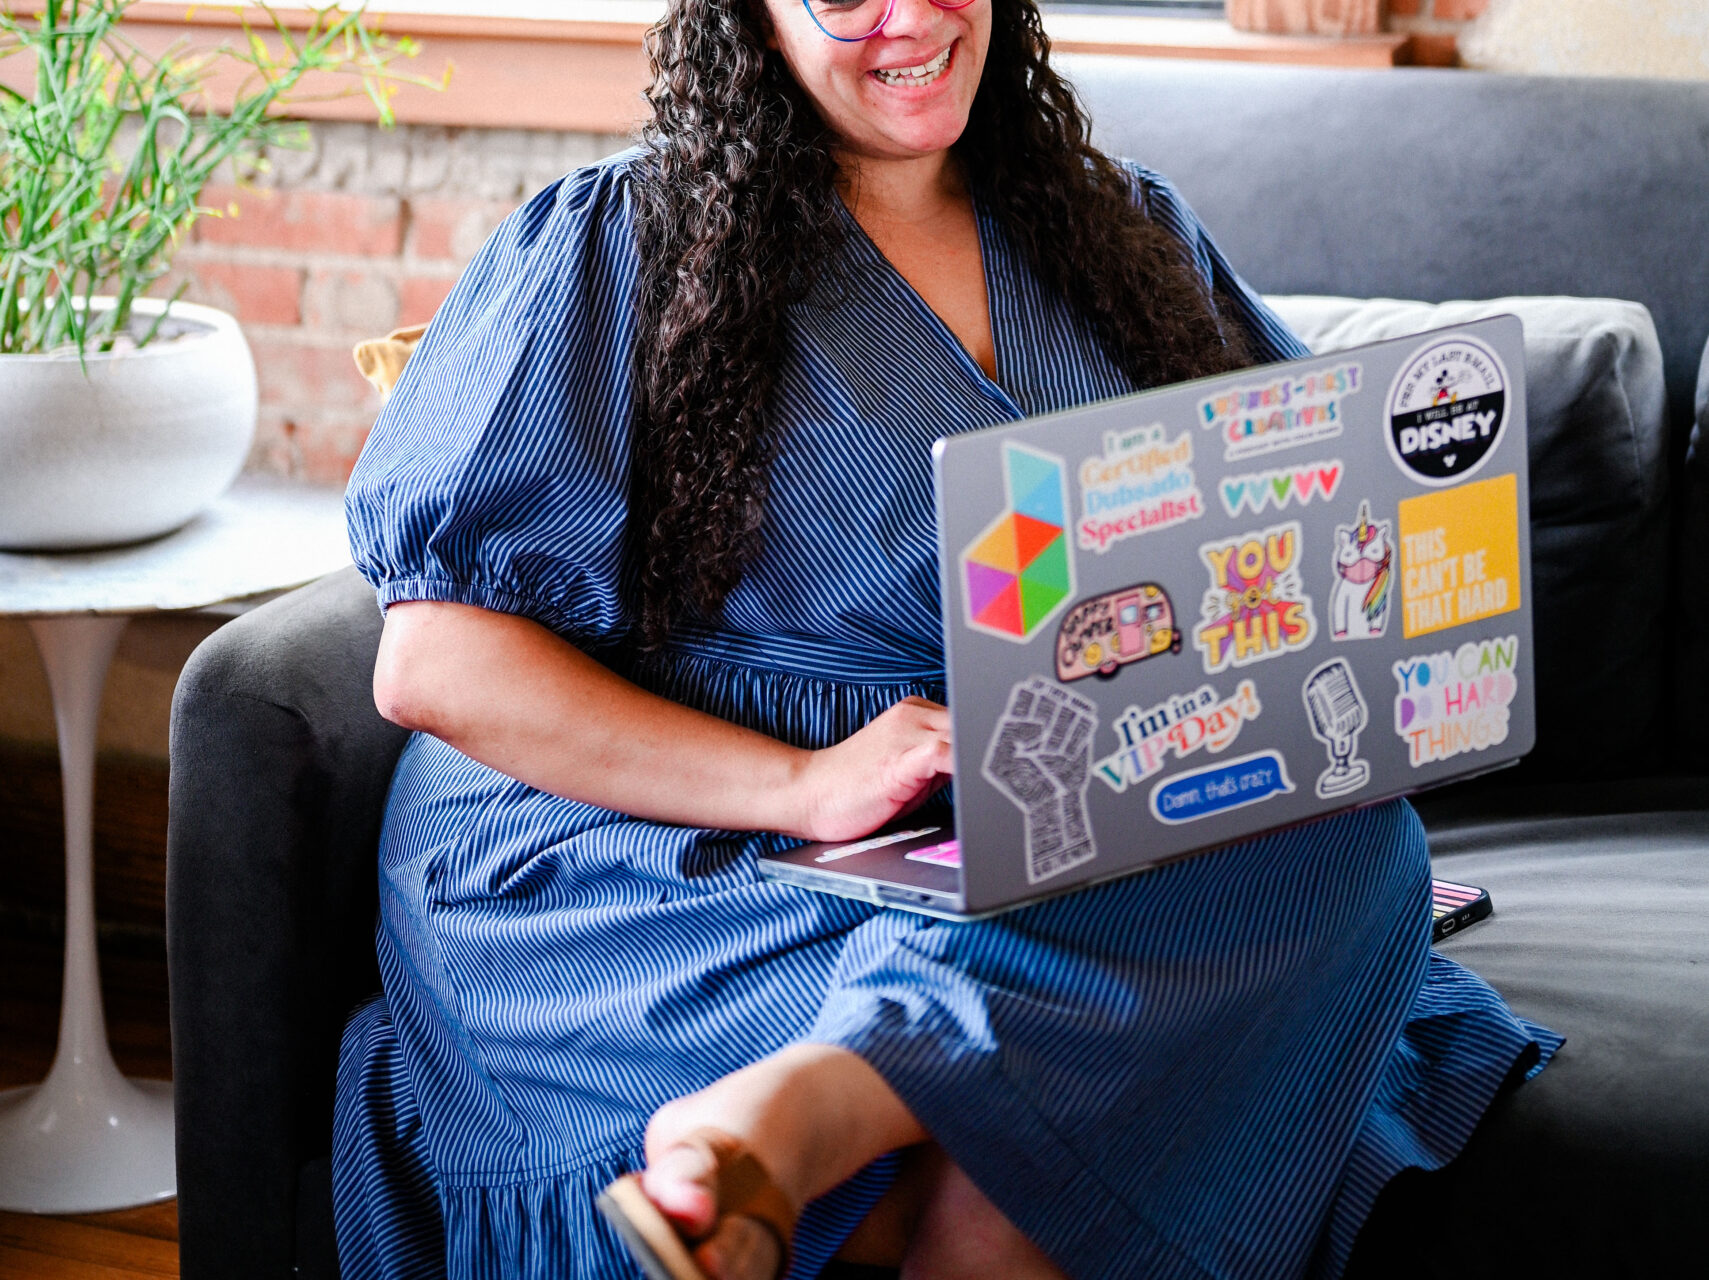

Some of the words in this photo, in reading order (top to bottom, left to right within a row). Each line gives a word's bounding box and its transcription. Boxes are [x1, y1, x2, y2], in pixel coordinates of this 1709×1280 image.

[1107, 436, 1114, 452] I
[1120, 432, 1144, 451] am
[1152, 428, 1161, 441] a
[1399, 408, 1497, 456] DISNEY
[1082, 437, 1192, 485] Certified
[1085, 469, 1192, 516] Dubsado
[1081, 494, 1200, 547] Specialist
[1402, 526, 1447, 566] THIS
[1206, 529, 1295, 588] YOU
[1405, 554, 1460, 600] CAN'T
[1462, 549, 1487, 586] BE
[1224, 576, 1281, 622] got
[1406, 589, 1456, 633] THAT
[1457, 577, 1508, 621] HARD
[1199, 602, 1310, 667] THIS
[1398, 658, 1450, 694] YOU
[1457, 640, 1516, 681] CAN
[1120, 706, 1170, 747] I'm
[1173, 697, 1195, 720] in
[1200, 690, 1212, 705] a
[1399, 694, 1434, 730] DO
[1444, 676, 1515, 718] HARD
[1099, 733, 1166, 787] VIP
[1167, 685, 1259, 753] Day!
[1408, 710, 1509, 763] THINGS
[1162, 789, 1204, 813] Damn,
[1204, 778, 1238, 803] that's
